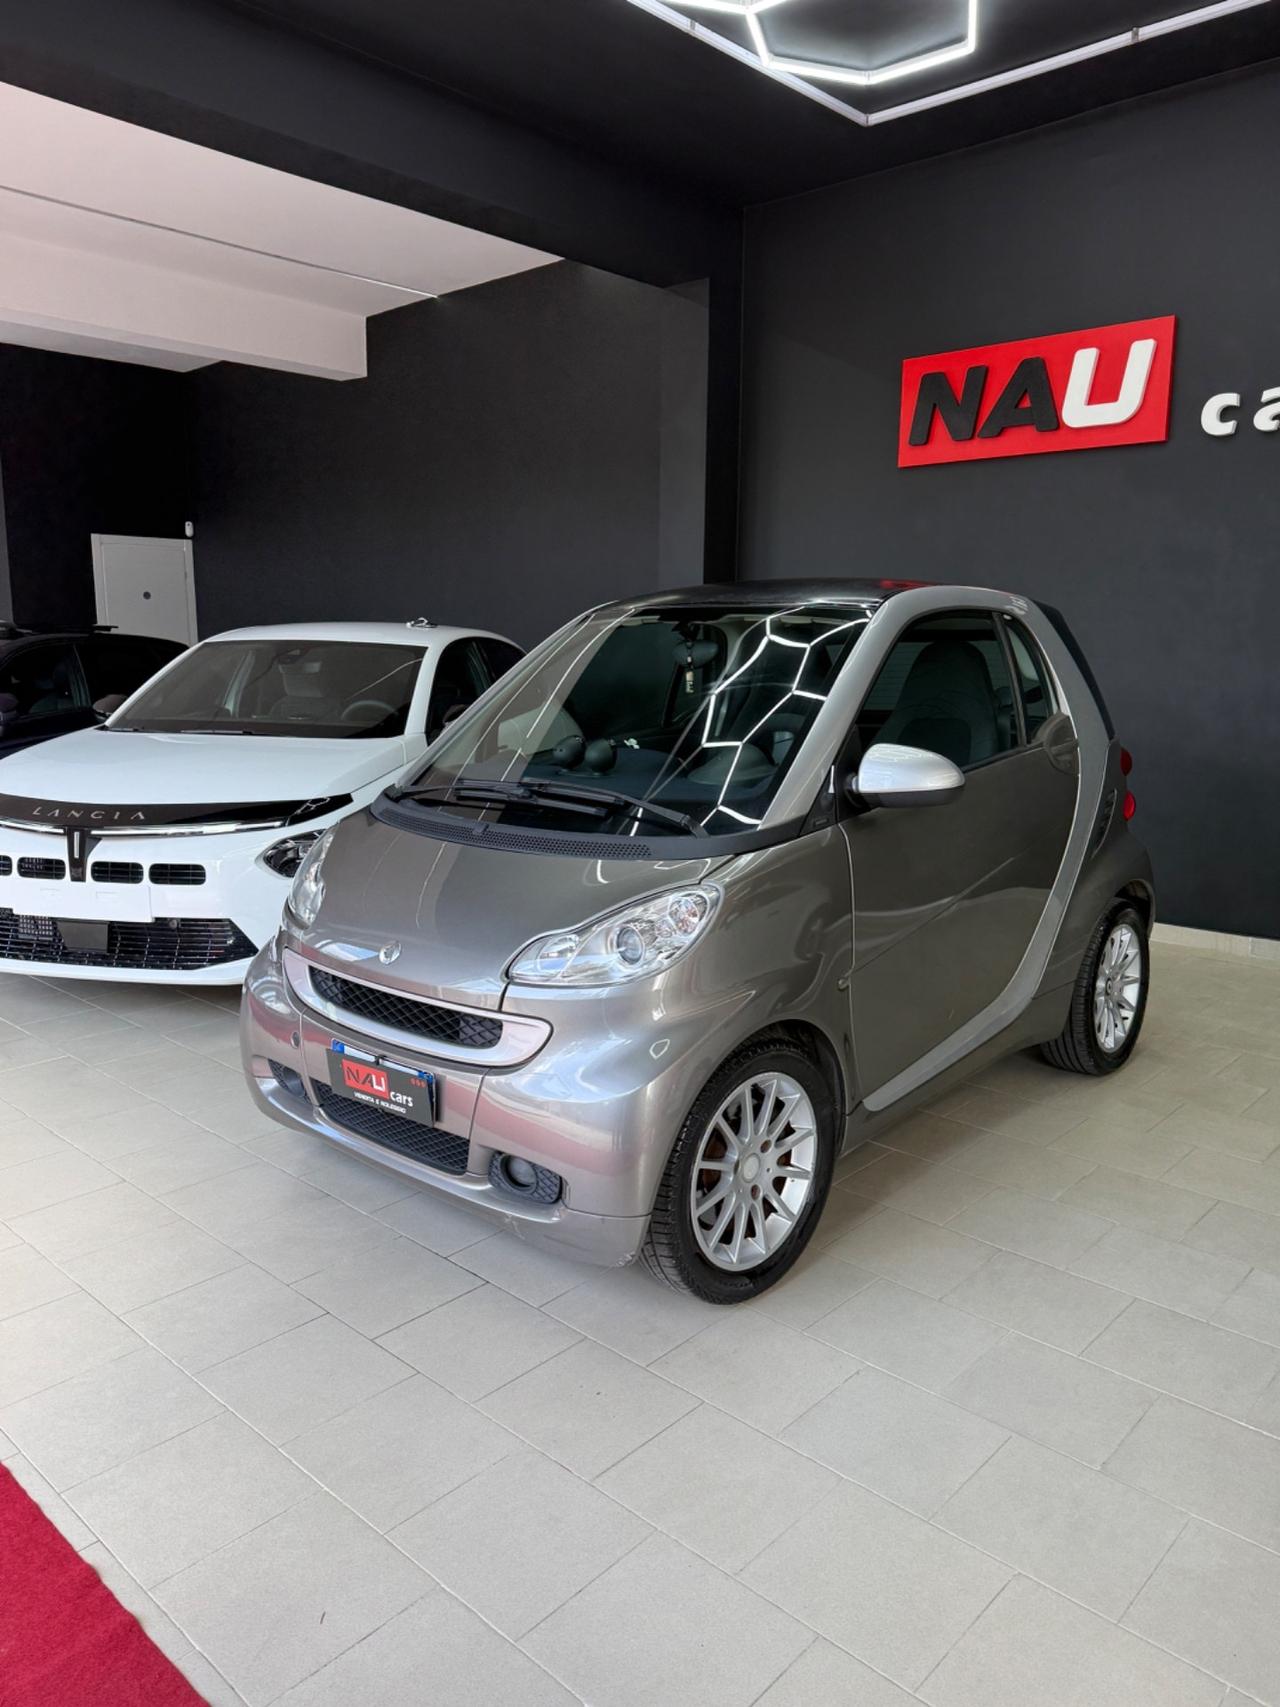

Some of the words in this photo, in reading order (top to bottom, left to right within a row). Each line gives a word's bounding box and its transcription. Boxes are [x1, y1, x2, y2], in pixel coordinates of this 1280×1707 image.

[909, 338, 1157, 446] NAU
[32, 806, 145, 820] LANCIA
[346, 1067, 386, 1091] NAU
[390, 1091, 413, 1107] cars
